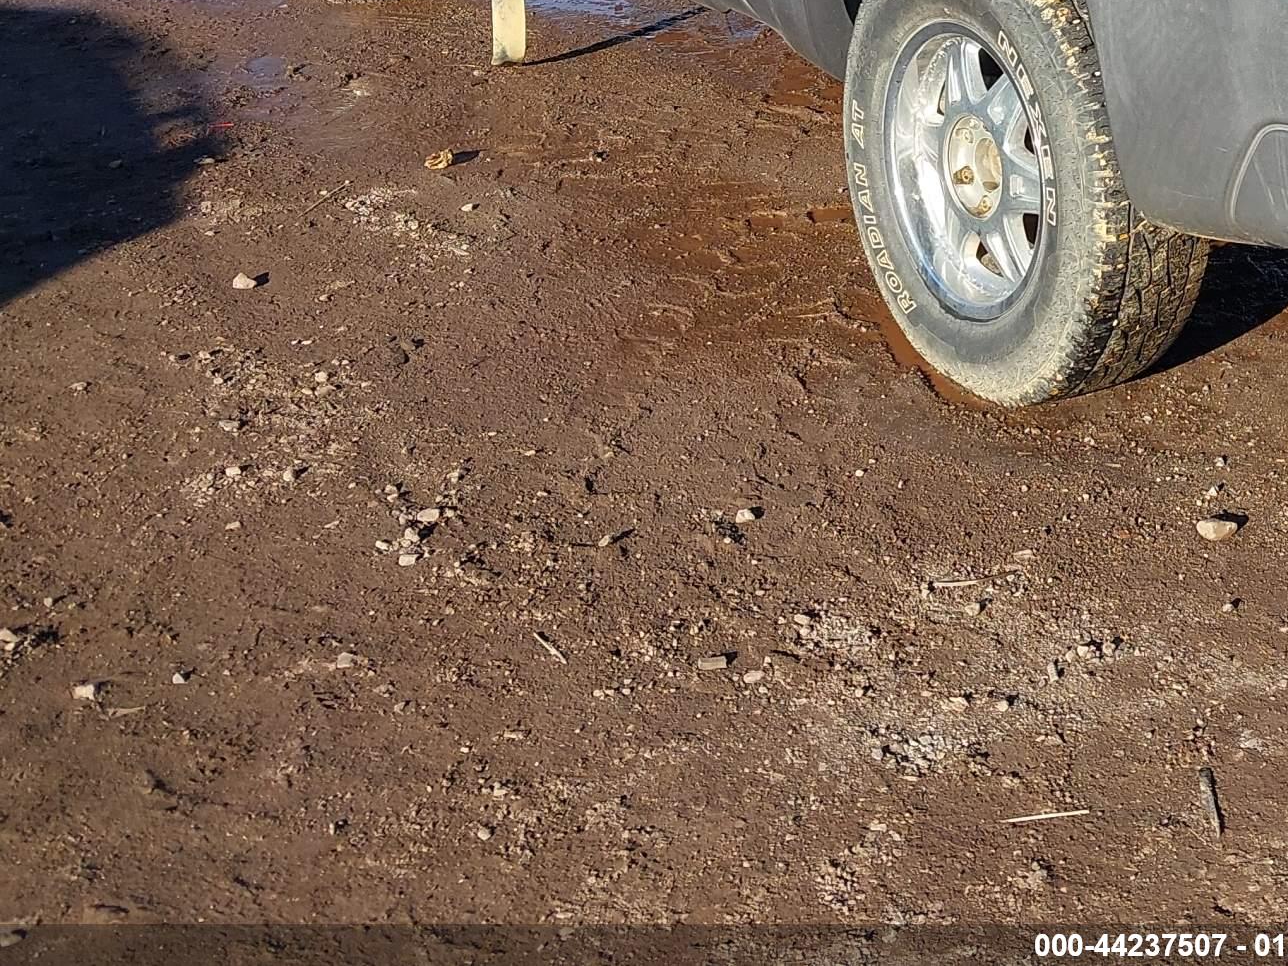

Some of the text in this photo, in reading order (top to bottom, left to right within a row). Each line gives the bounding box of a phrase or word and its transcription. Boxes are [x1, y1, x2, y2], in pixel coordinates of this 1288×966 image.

[849, 98, 915, 315] ROADIAN AT
[997, 29, 1058, 227] NEXEN
